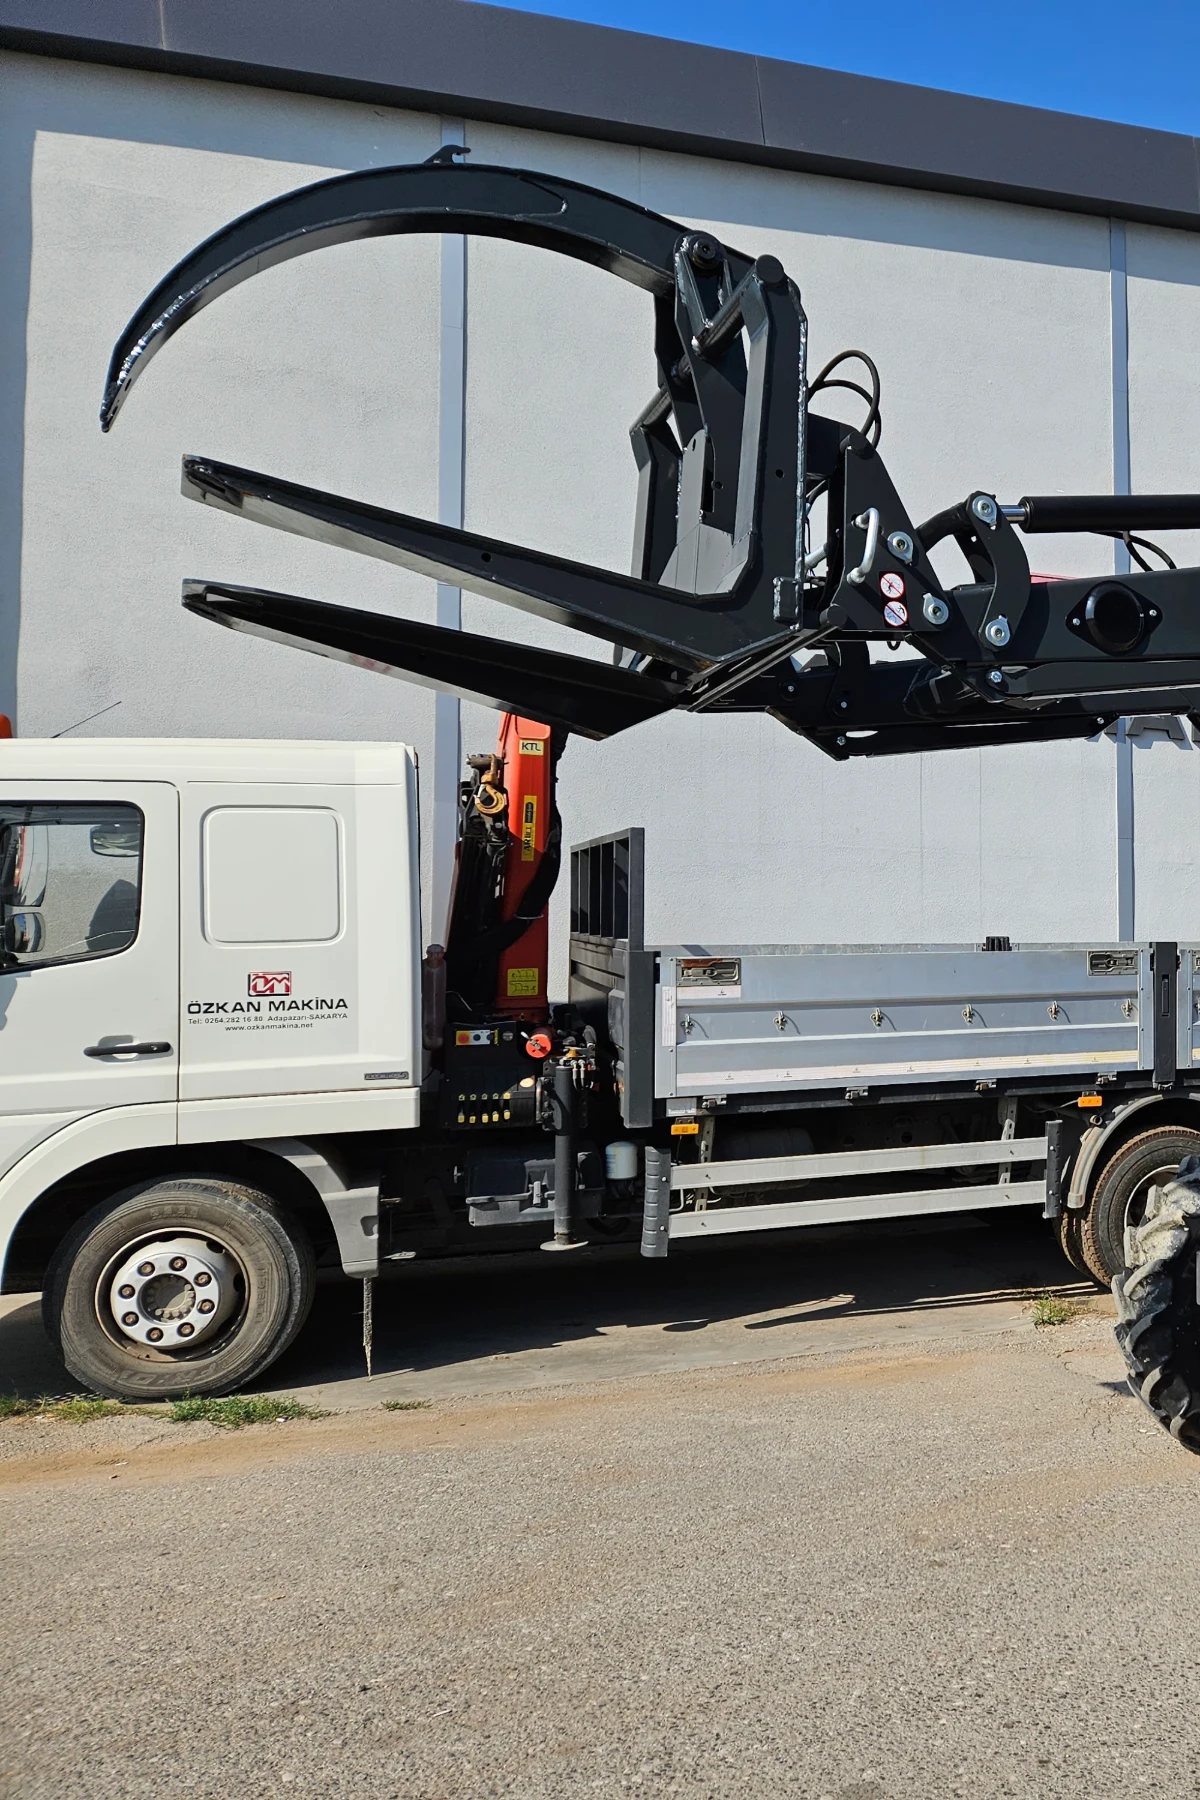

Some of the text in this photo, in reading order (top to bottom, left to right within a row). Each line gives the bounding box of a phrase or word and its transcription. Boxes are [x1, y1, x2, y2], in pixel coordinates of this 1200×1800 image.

[187, 996, 349, 1015] ÖZKAN MAKİNA
[225, 1022, 314, 1032] www.ozkanmakina.net
